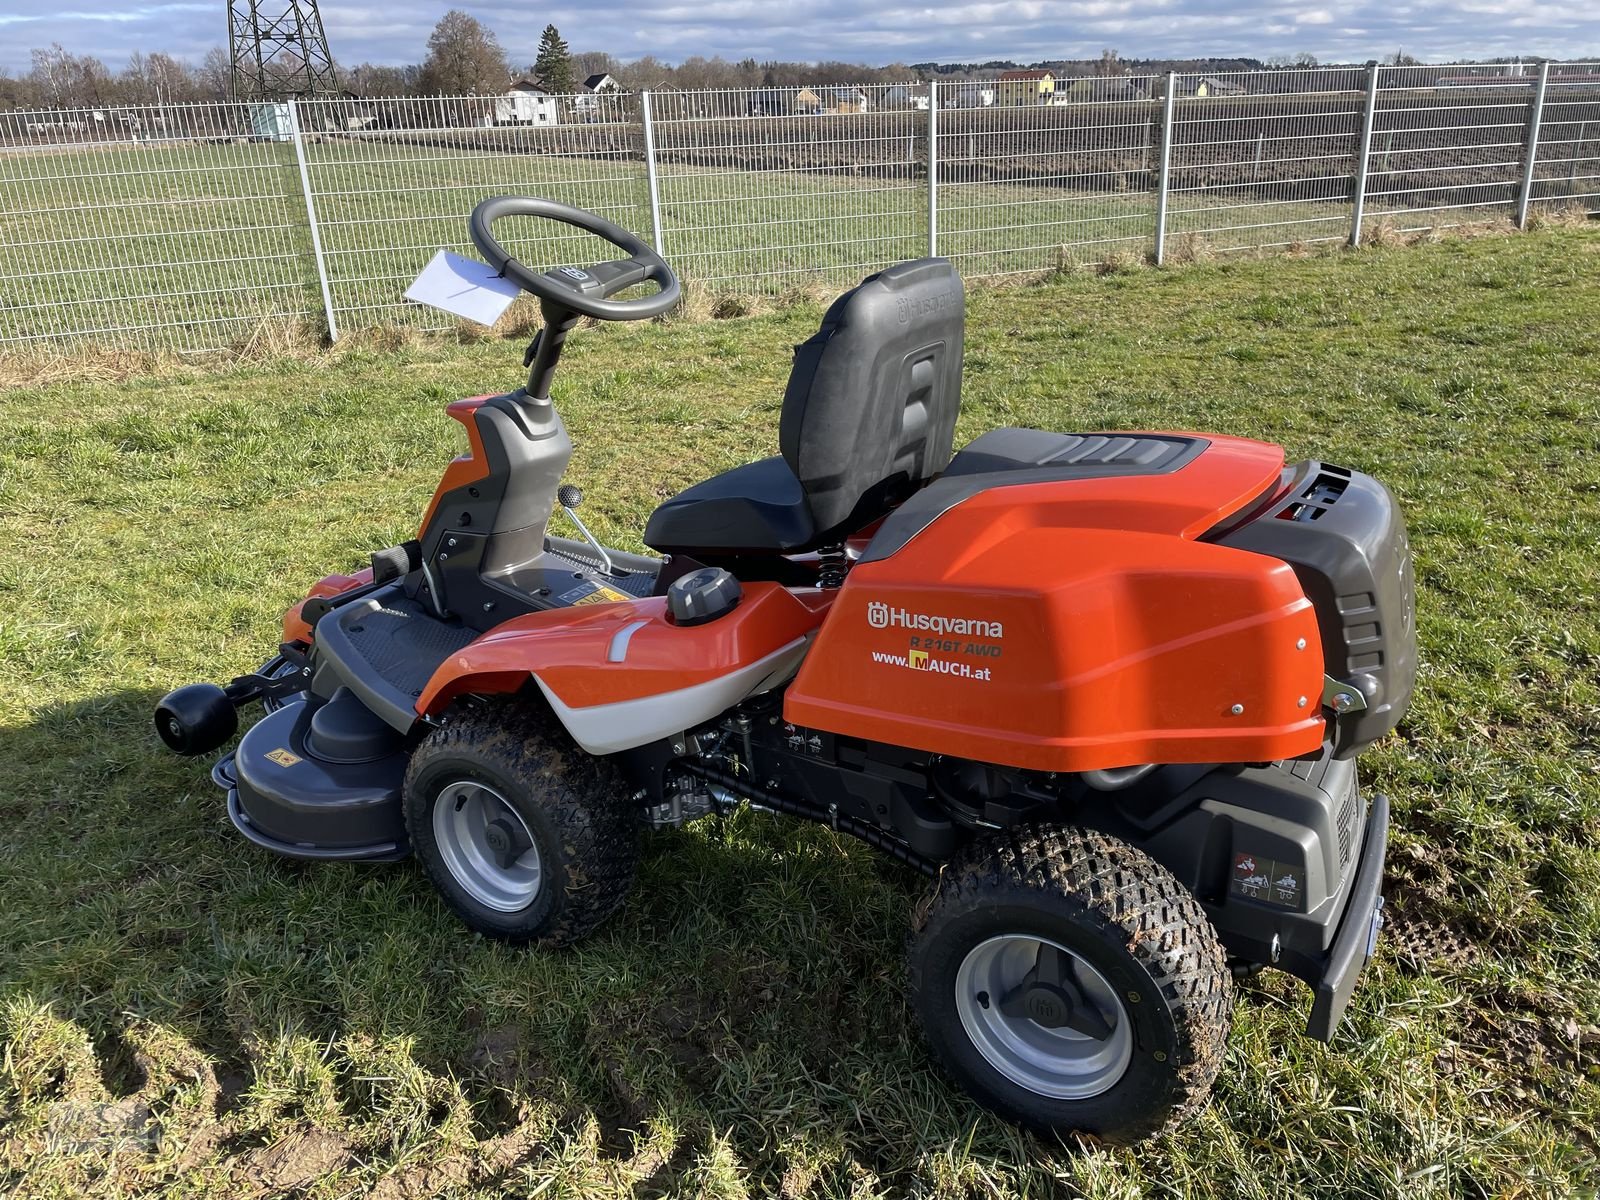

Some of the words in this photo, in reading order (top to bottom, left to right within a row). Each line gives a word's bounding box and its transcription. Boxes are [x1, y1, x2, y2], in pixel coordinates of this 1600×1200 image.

[909, 291, 958, 319] Husqva
[890, 607, 1003, 638] Husqvarna
[909, 635, 921, 647] R
[924, 637, 961, 653] 216T
[964, 643, 1003, 657] AWD
[871, 650, 991, 681] www.MAUCH.at
